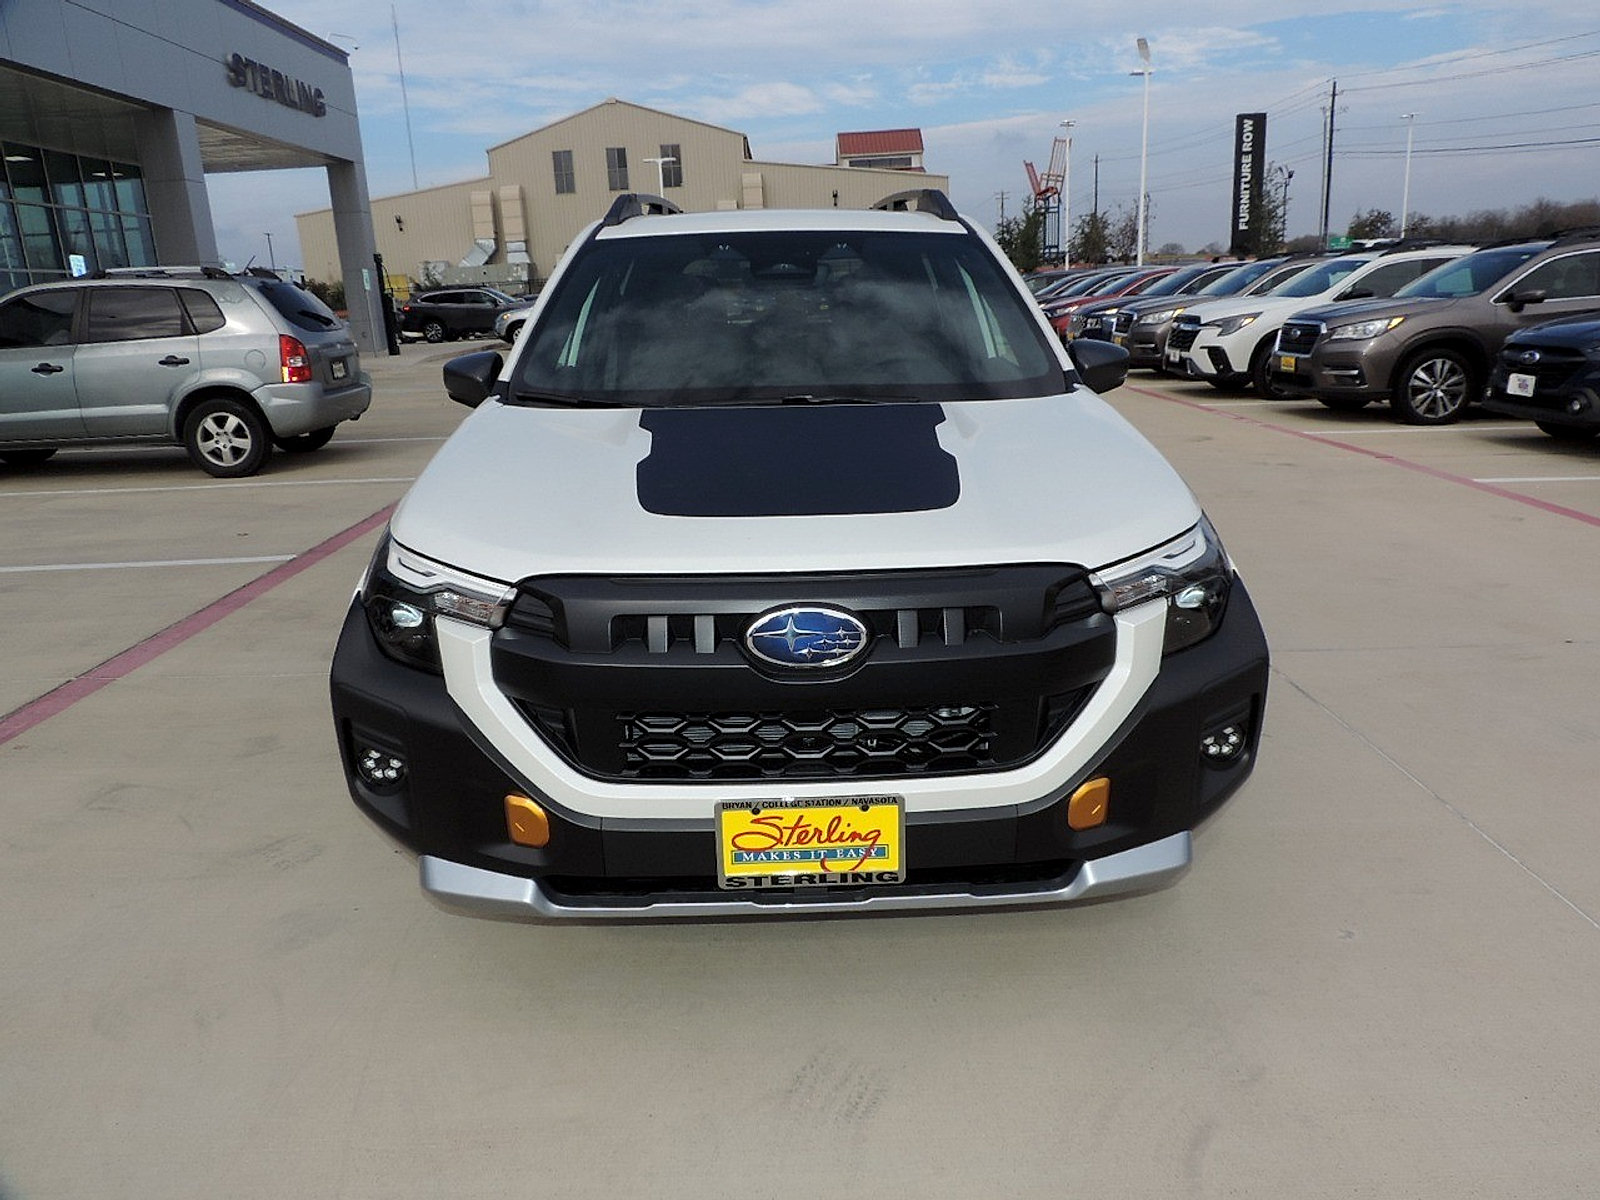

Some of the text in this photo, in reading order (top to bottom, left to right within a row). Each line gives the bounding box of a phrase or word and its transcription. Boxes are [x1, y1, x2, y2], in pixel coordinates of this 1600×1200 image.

[226, 52, 327, 118] STERLING
[1239, 119, 1254, 230] FURNITURE ROW
[722, 801, 752, 810] BRYAN
[805, 798, 842, 808] STATION
[851, 796, 898, 805] NAVASOTA
[731, 814, 882, 873] Sterling
[741, 847, 878, 862] MAKES IT EASY
[725, 872, 899, 888] STERLING
